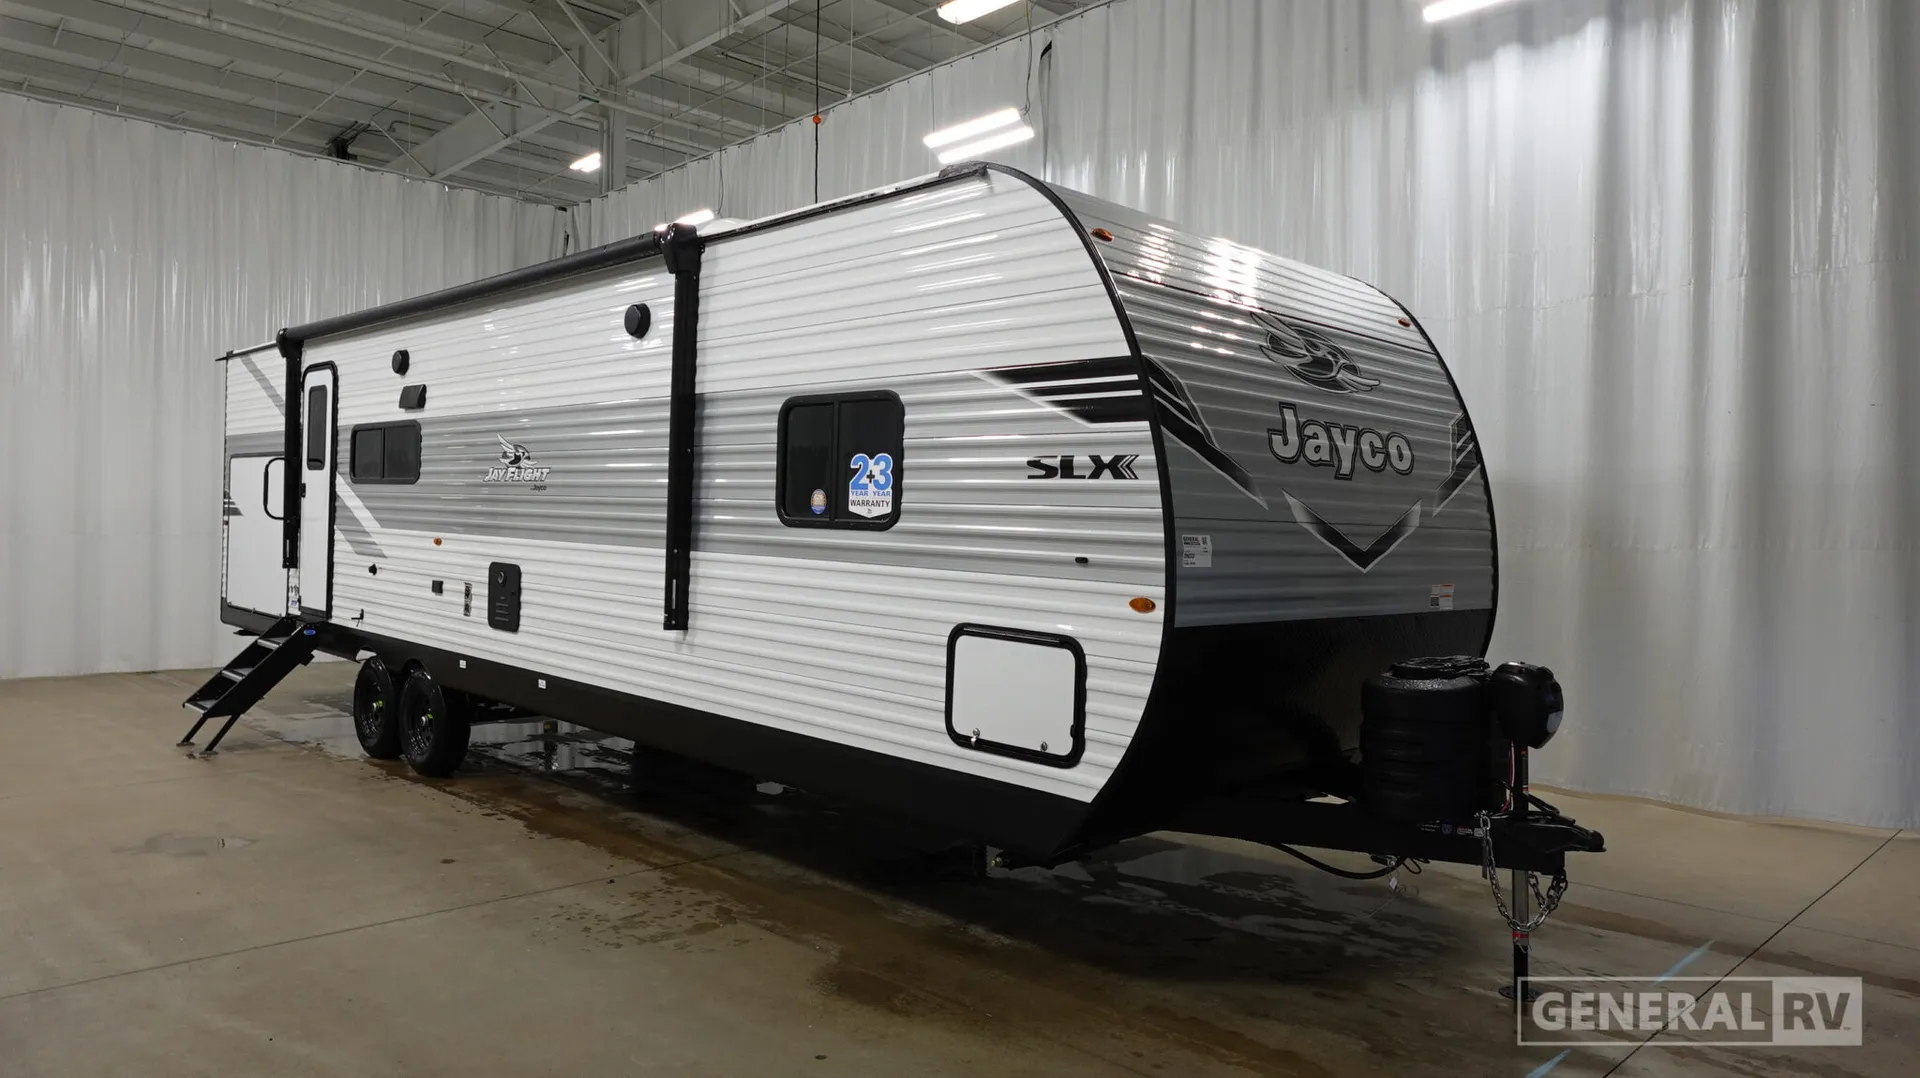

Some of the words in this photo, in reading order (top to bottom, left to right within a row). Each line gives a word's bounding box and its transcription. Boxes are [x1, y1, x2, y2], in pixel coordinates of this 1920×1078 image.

[1267, 402, 1414, 480] Jayco
[483, 467, 506, 482] JAY
[504, 467, 551, 482] FLIGHT
[1026, 454, 1139, 480] SLX
[850, 500, 890, 508] WARRANTY
